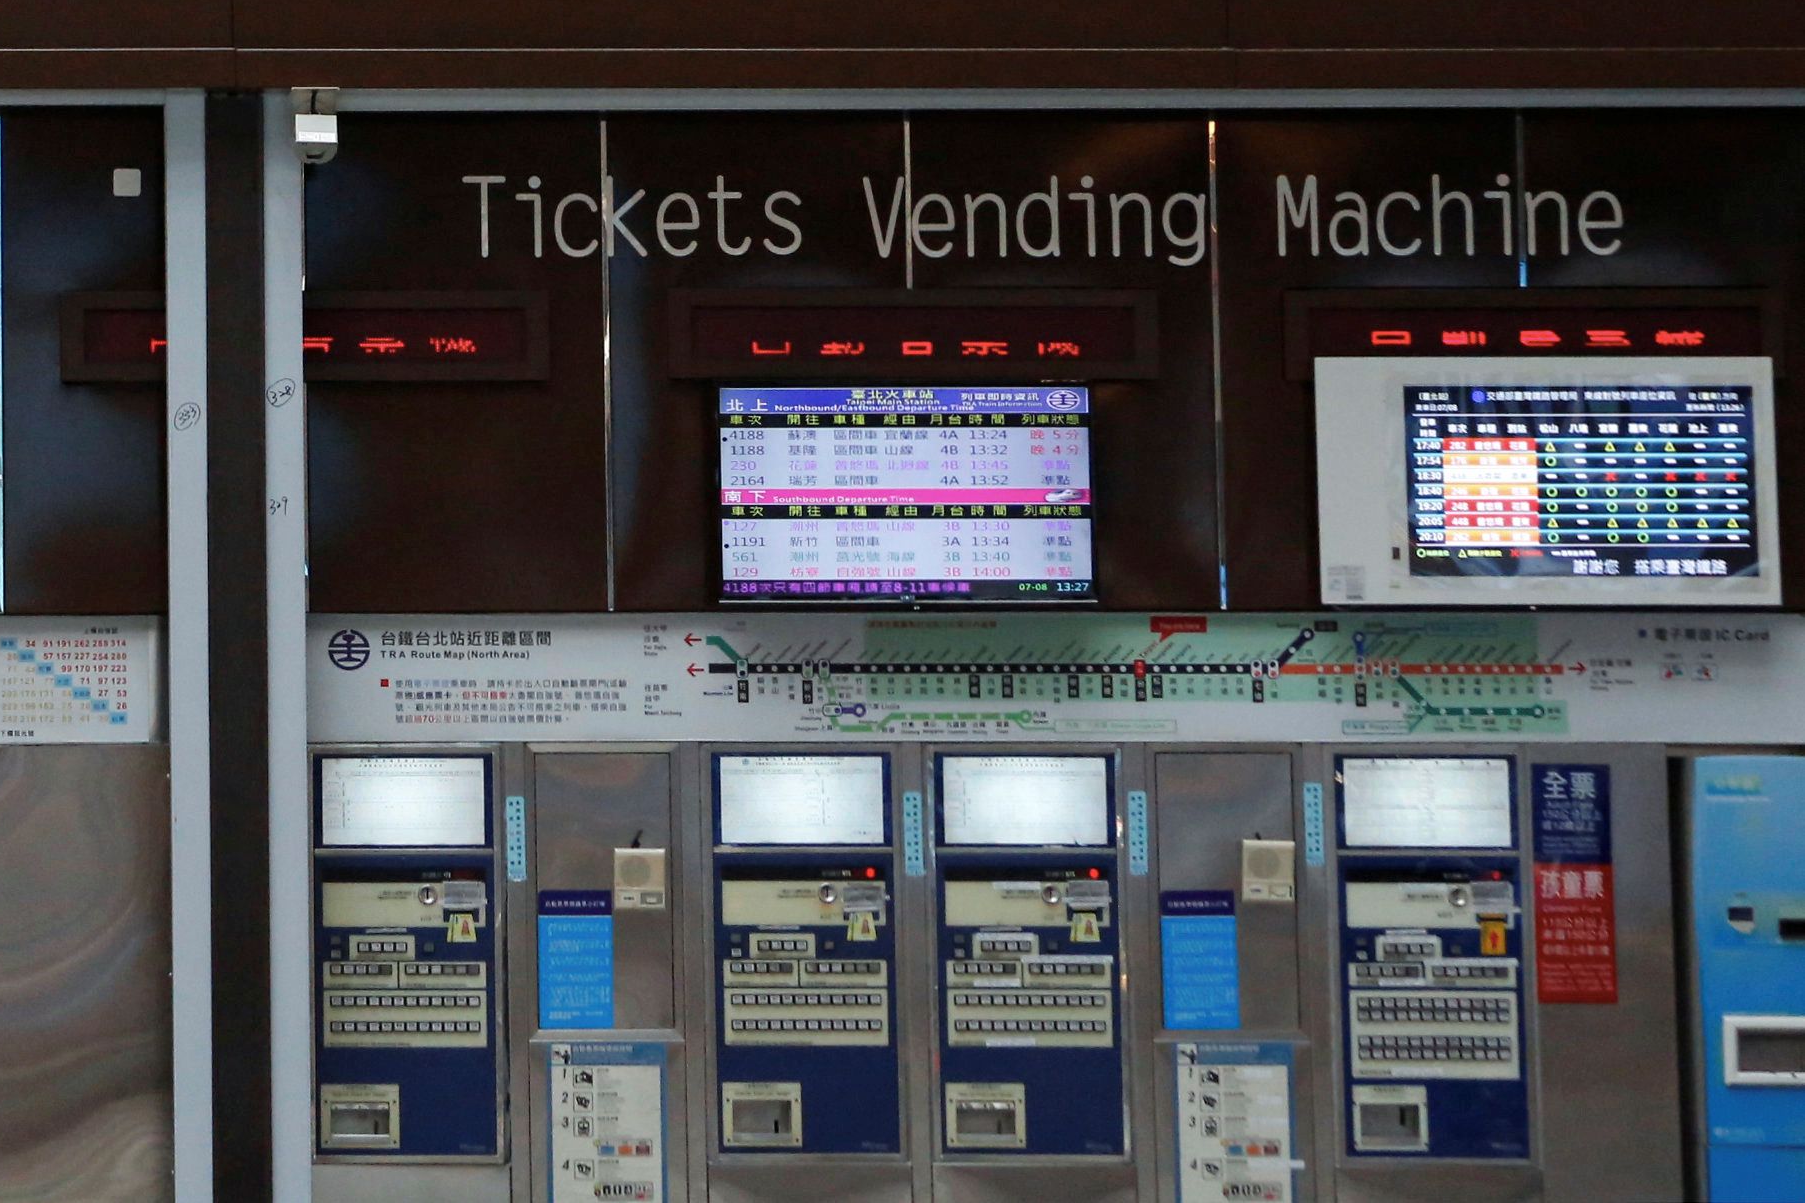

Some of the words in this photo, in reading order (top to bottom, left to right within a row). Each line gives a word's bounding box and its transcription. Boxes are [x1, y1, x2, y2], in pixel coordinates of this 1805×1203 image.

[462, 174, 803, 258] Tickets
[862, 173, 1207, 266] Vending
[1276, 173, 1625, 258] Machine
[851, 389, 934, 399] 臺北火車站
[726, 399, 768, 411] 北上
[775, 404, 894, 412] Northbound/Eastbound
[897, 404, 947, 413] Departure
[950, 404, 973, 412] Time
[730, 414, 762, 425] 車次
[787, 414, 819, 425] 開往
[834, 414, 865, 425] 車種
[883, 414, 916, 425] 經由
[930, 414, 962, 426] 月台
[969, 414, 1005, 425] 時間
[1021, 414, 1079, 425] 列車狀態
[729, 430, 764, 441] 4188
[939, 430, 958, 441] 4A
[970, 430, 1007, 441] 13:24
[730, 446, 765, 456] 1188
[940, 446, 958, 455] 4B
[970, 446, 1008, 456] 13:32
[730, 461, 756, 471] 230
[940, 461, 959, 470] 4B
[970, 460, 1008, 470] 13:45
[730, 475, 765, 486] 2164
[940, 476, 959, 486] 4A
[971, 475, 1008, 486] 13:52
[724, 491, 766, 503] 南下
[731, 506, 764, 517] 車次
[789, 506, 821, 517] 開往
[835, 506, 867, 517] 車種
[885, 505, 918, 517] 經由
[932, 505, 964, 517] 月台
[971, 505, 1007, 516] 時間
[1023, 505, 1081, 516] 列車狀態
[733, 522, 757, 532] 127
[944, 522, 960, 531] 3B
[972, 521, 1009, 532] 13:30
[733, 536, 766, 547] 1191
[942, 536, 960, 546] 3A
[972, 536, 1009, 547] 13:34
[732, 552, 757, 562] 561
[944, 552, 961, 562] 3B
[972, 552, 1010, 562] 13:40
[733, 567, 758, 577] 129
[944, 567, 961, 577] 3B
[972, 567, 1010, 577] 14:00
[1057, 583, 1089, 591] 13:27
[381, 631, 552, 646] 台鐵台北站近距離區間
[1716, 630, 1730, 641] IC
[1735, 629, 1769, 641] Card
[411, 650, 441, 659] Route
[444, 650, 464, 661] Map
[467, 649, 500, 661] (North
[503, 649, 530, 660] Area)
[1543, 771, 1597, 799] 全票
